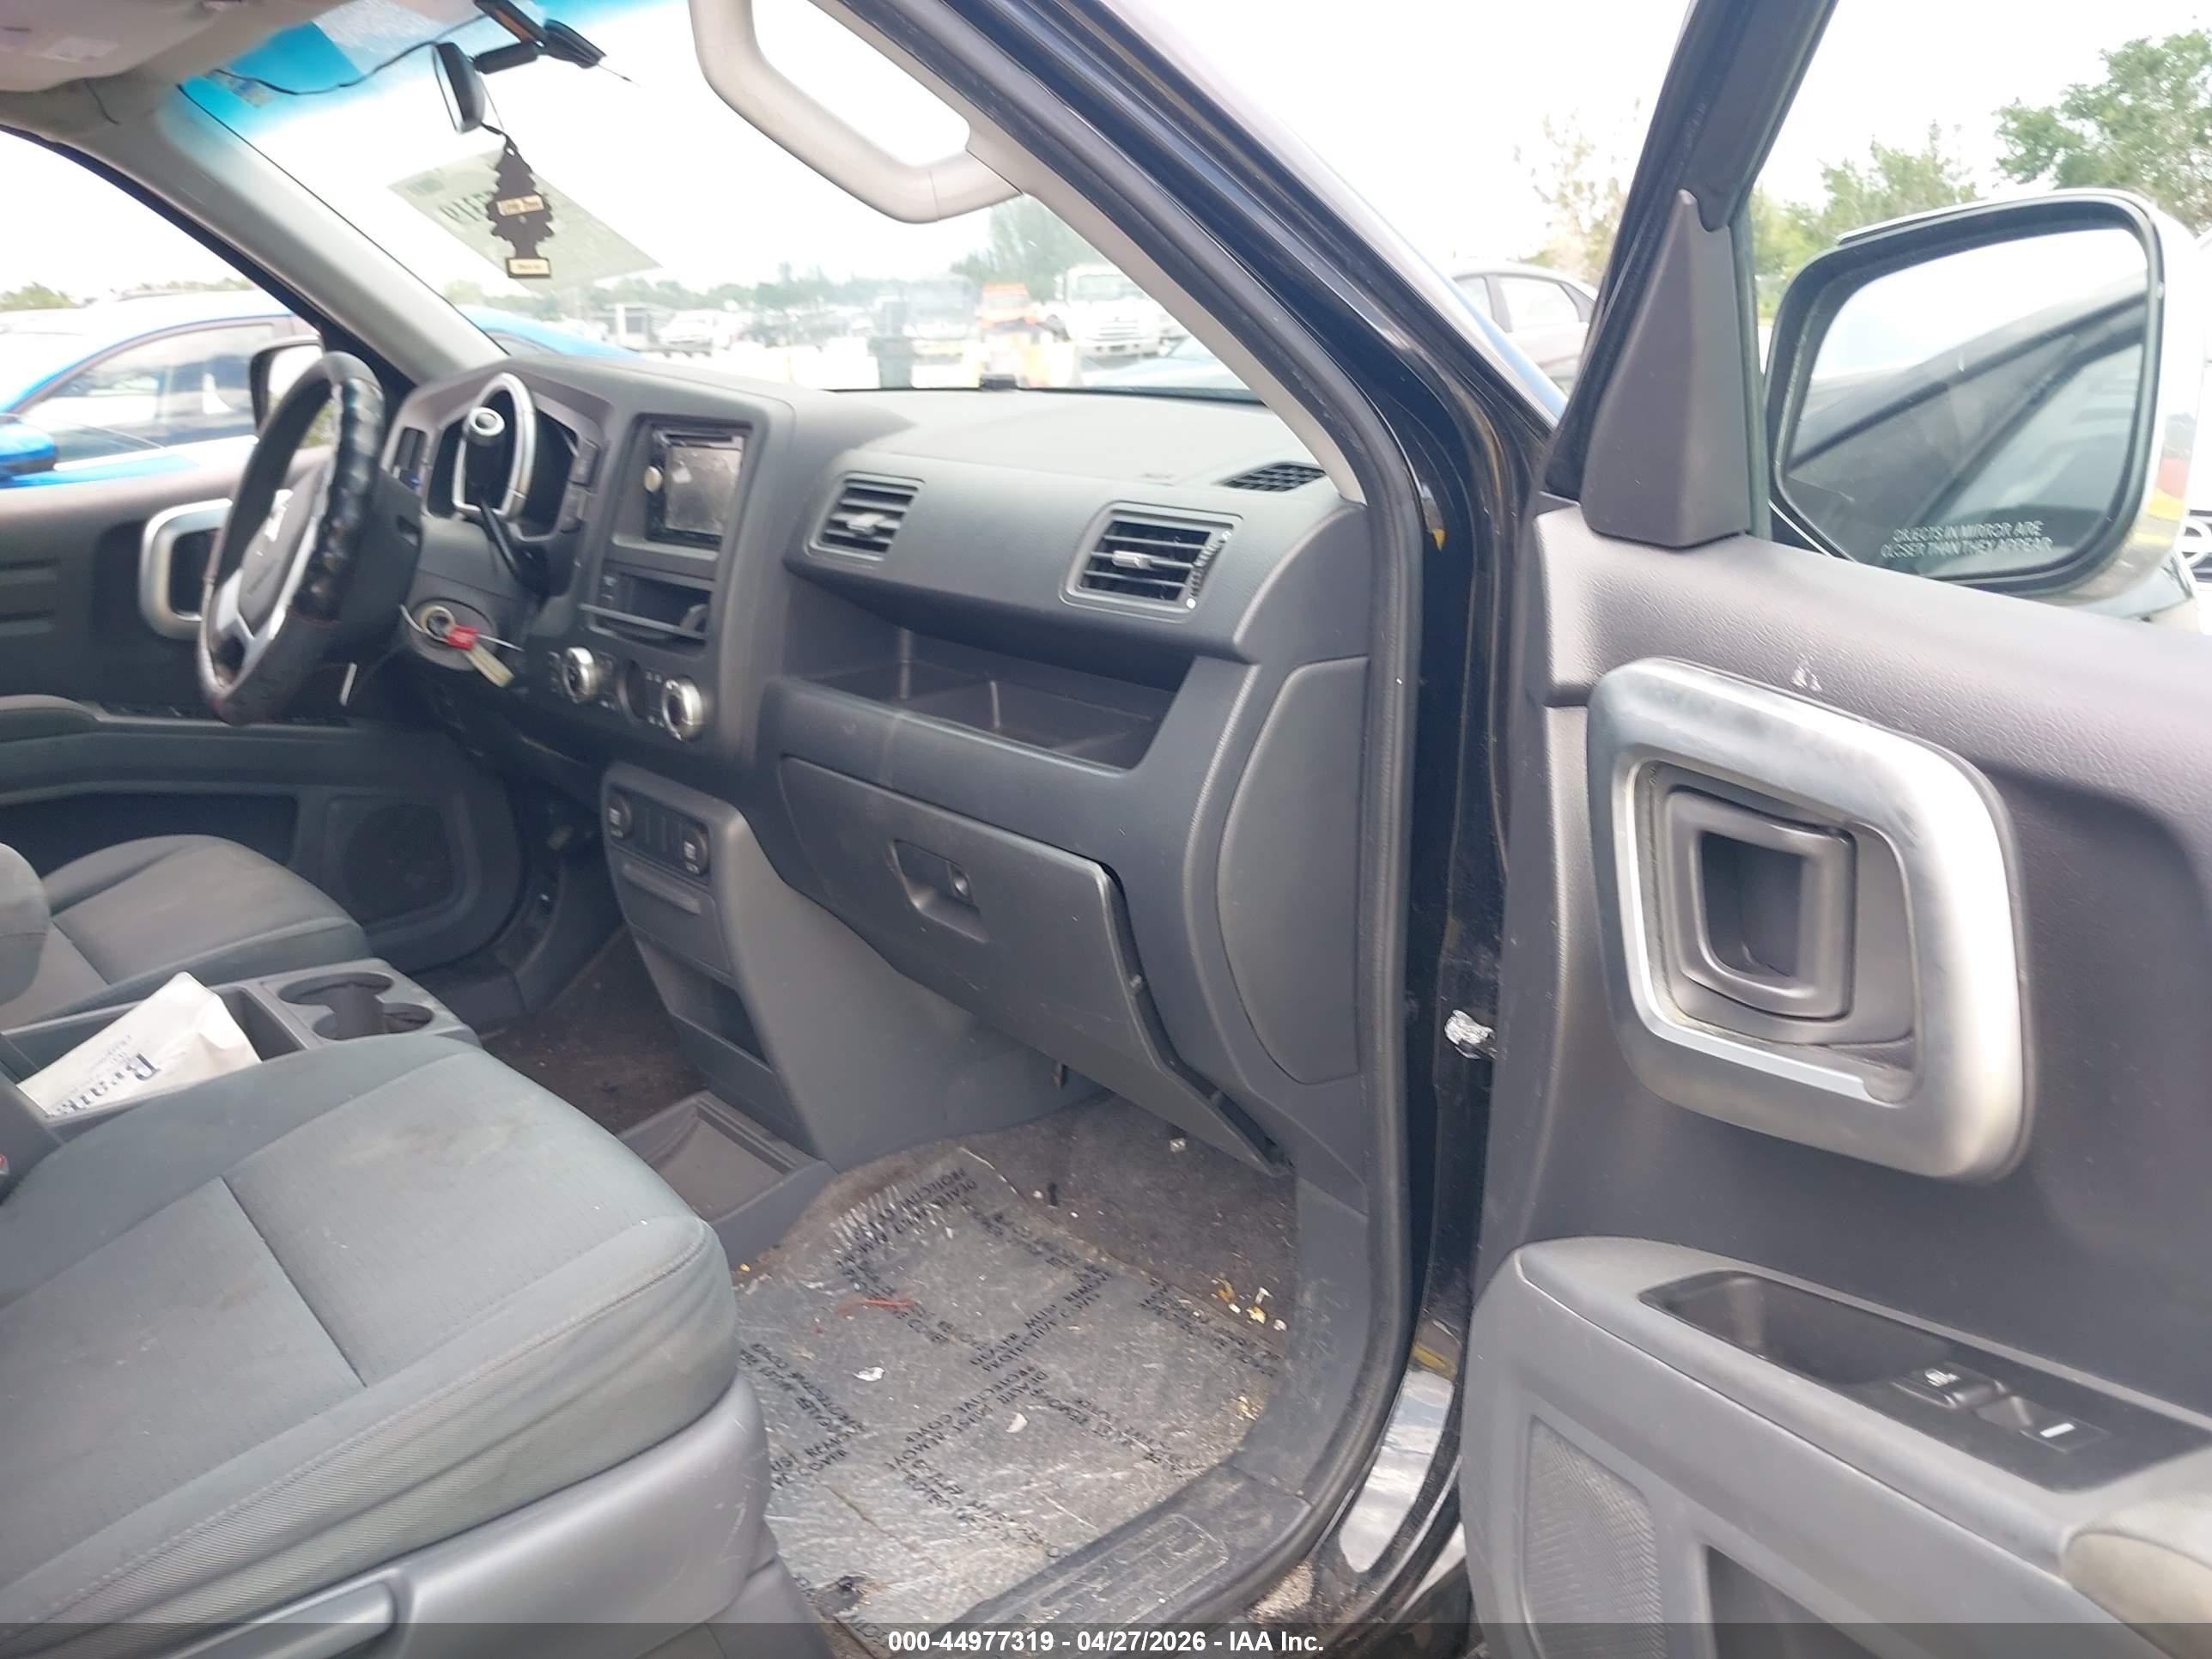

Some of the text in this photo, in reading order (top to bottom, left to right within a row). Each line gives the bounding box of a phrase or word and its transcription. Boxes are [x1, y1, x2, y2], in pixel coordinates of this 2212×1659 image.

[1960, 522, 2012, 538] MIRROR
[2014, 520, 2044, 537] ARE
[1927, 540, 1961, 556] THAN
[1995, 537, 2053, 552] APPEAR
